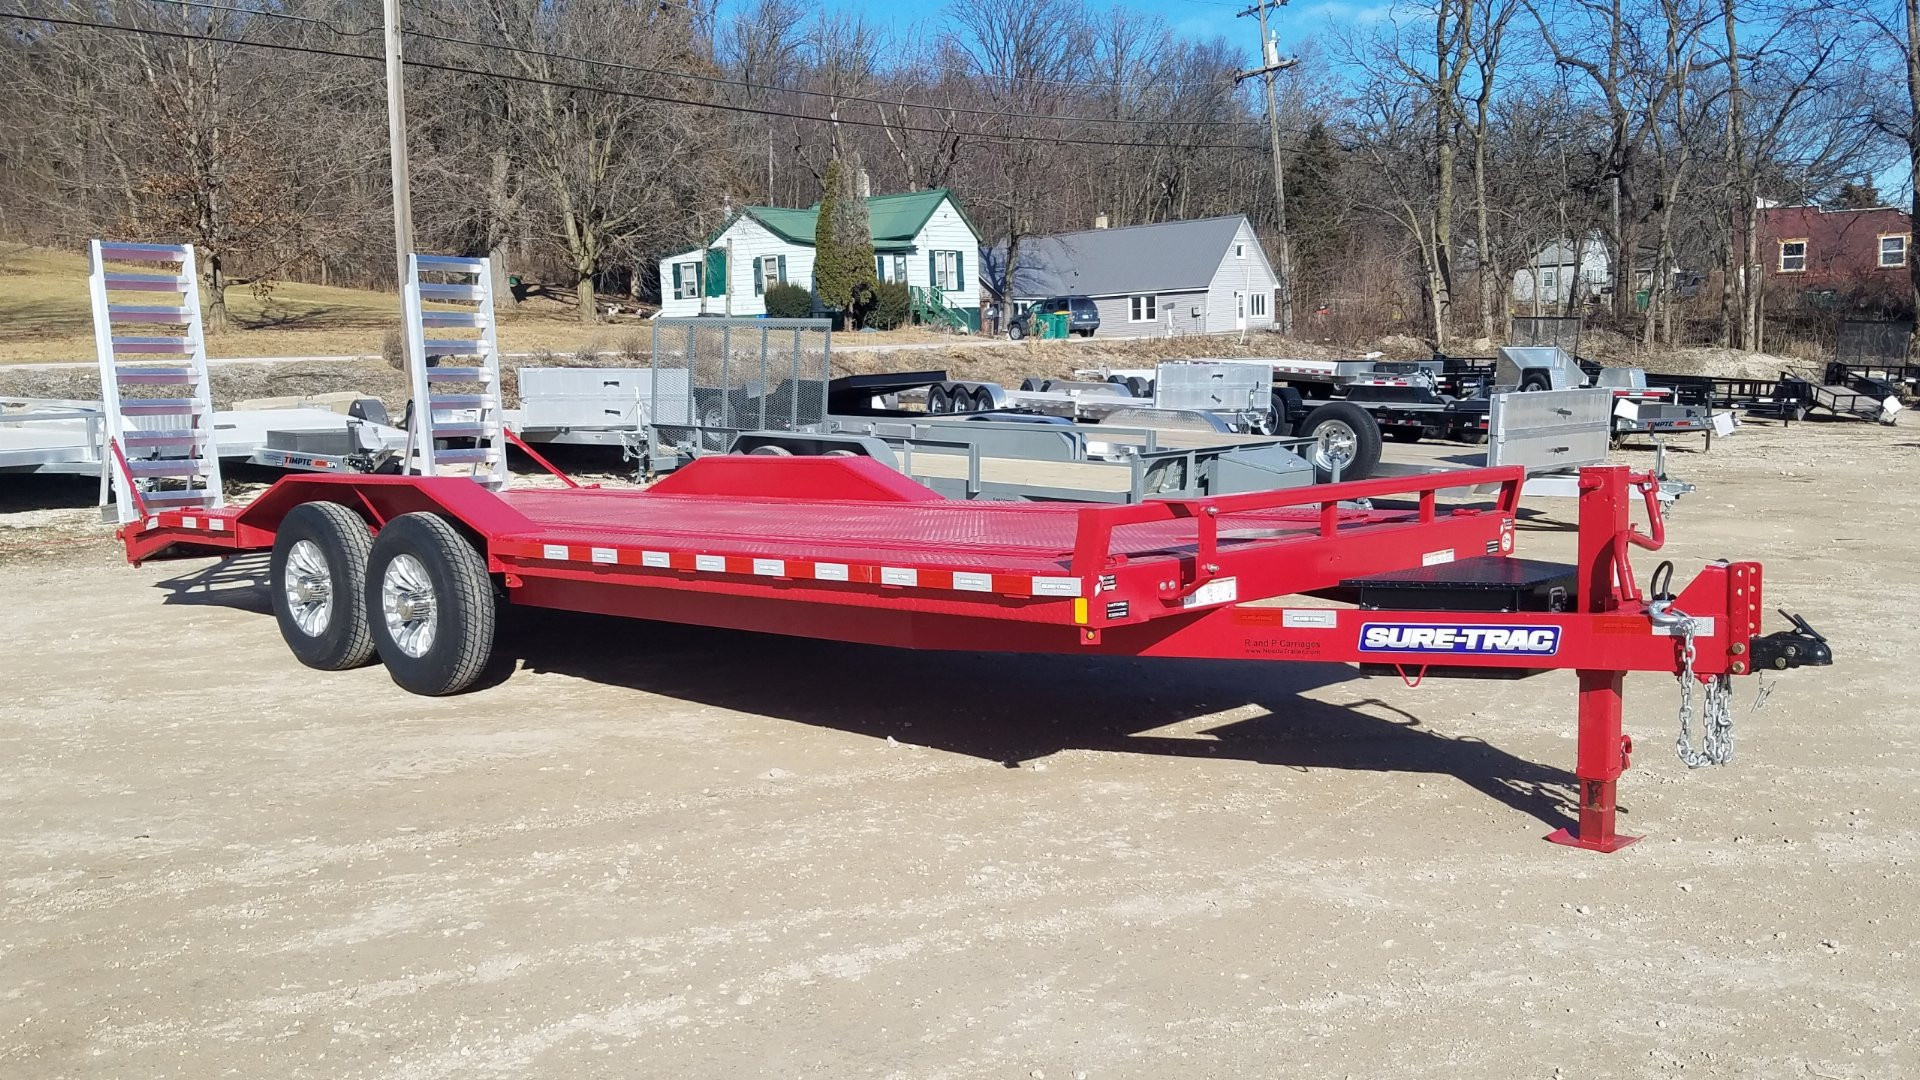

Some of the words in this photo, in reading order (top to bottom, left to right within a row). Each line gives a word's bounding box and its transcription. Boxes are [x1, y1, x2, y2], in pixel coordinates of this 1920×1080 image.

[1244, 639, 1251, 647] R
[1253, 639, 1269, 647] and
[1271, 639, 1278, 647] P
[1279, 640, 1321, 650] Carriages
[1364, 627, 1555, 651] SURE-TRAC
